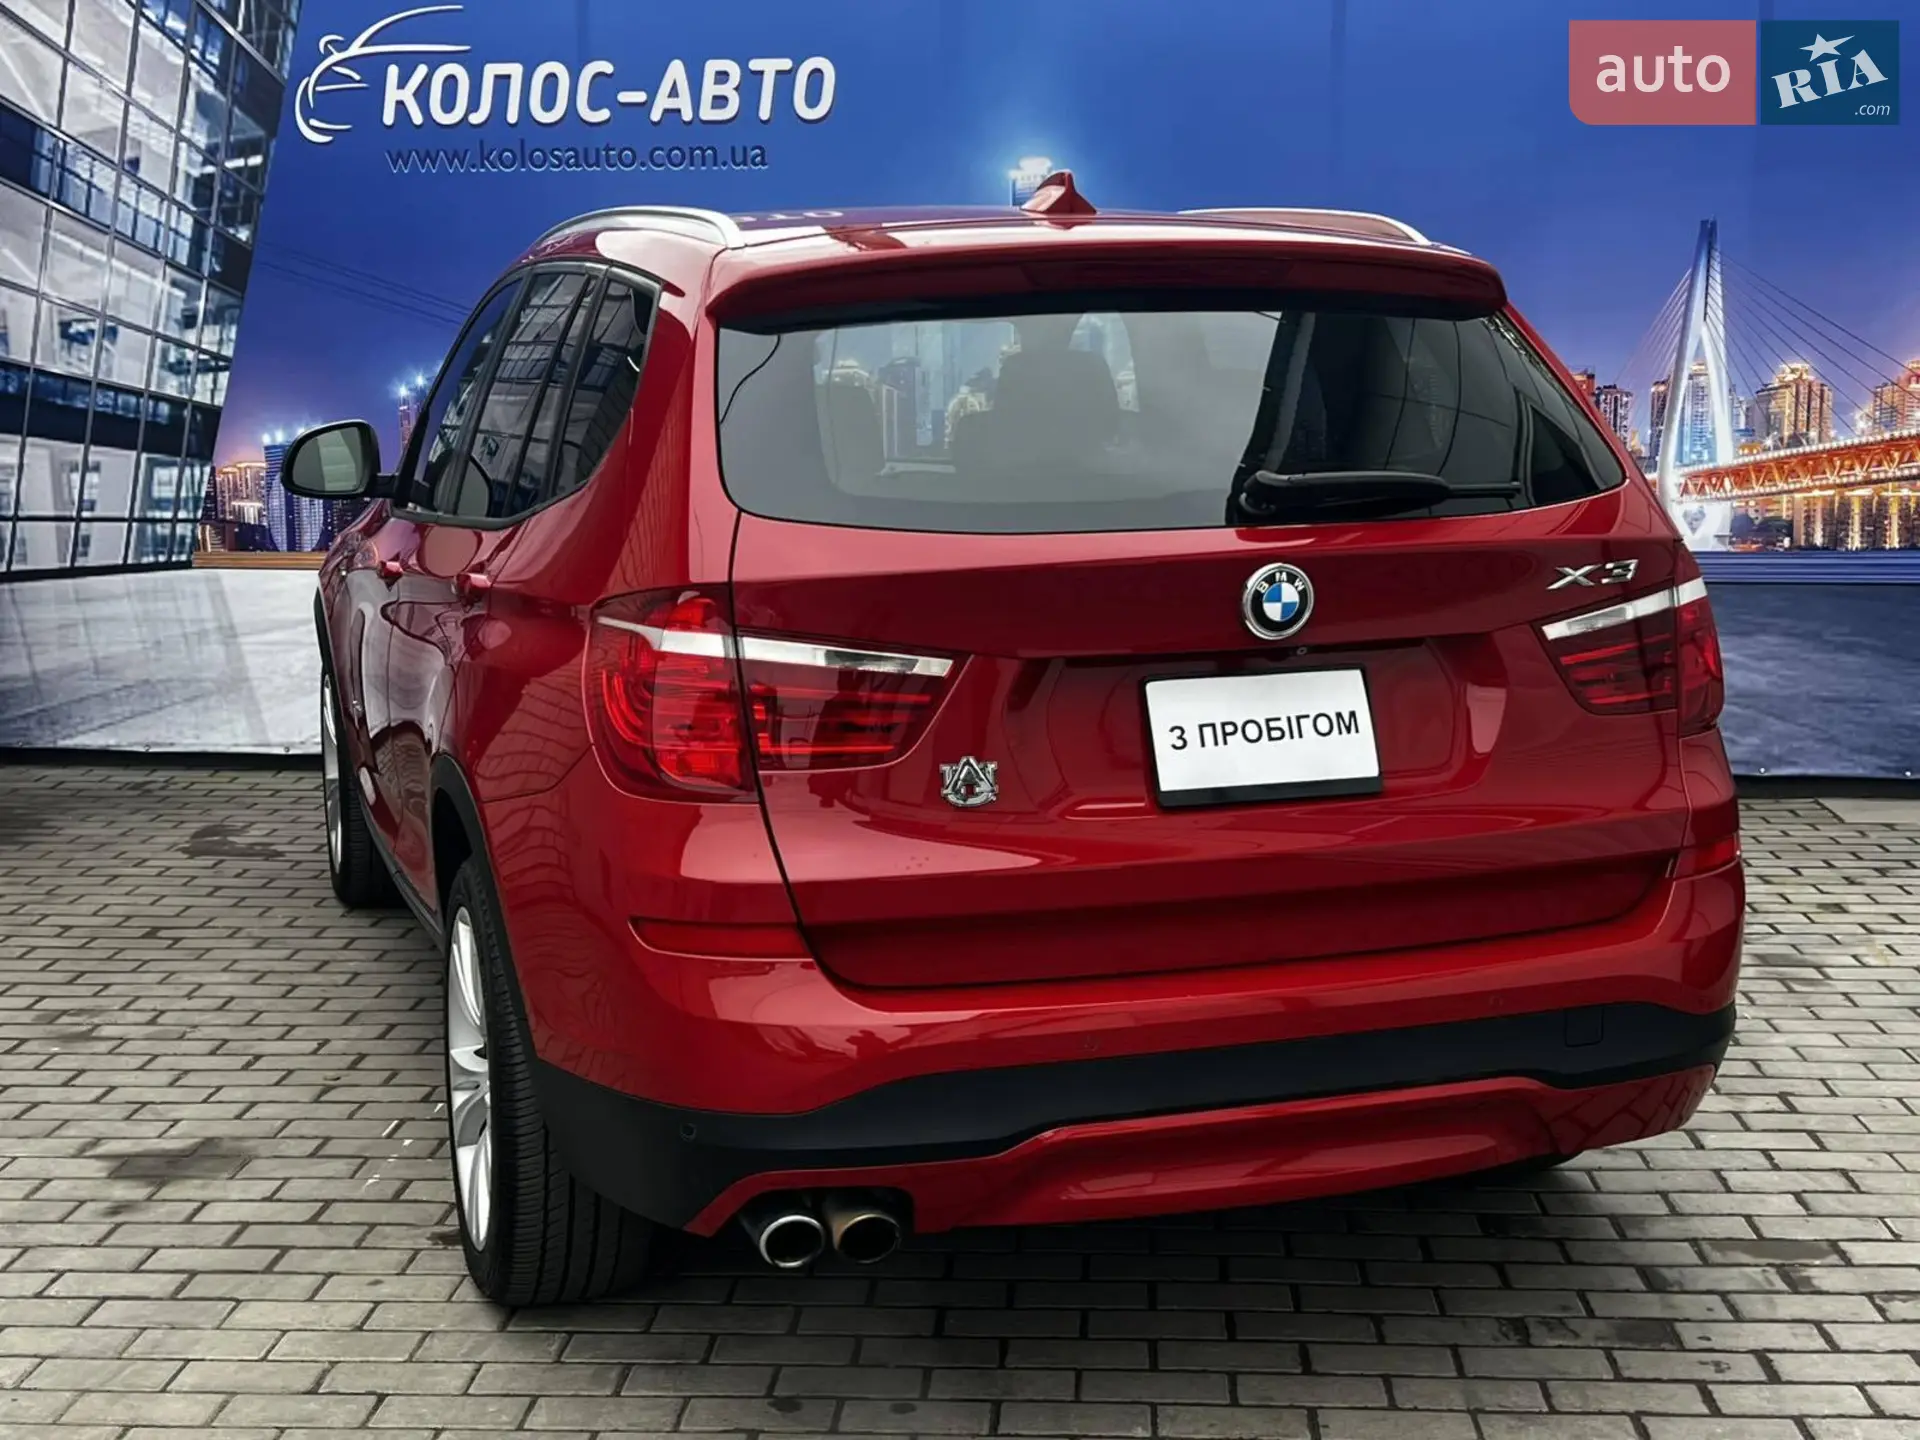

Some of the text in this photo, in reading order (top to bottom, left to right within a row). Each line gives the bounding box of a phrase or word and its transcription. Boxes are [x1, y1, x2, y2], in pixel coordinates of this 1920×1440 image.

[382, 57, 836, 126] КОЛОС-АВТО
[386, 140, 768, 174] www.kolosauto.com.ua
[1256, 572, 1305, 594] BMW
[1546, 559, 1639, 590] X3
[1198, 710, 1360, 748] ПРОБІГОМ
